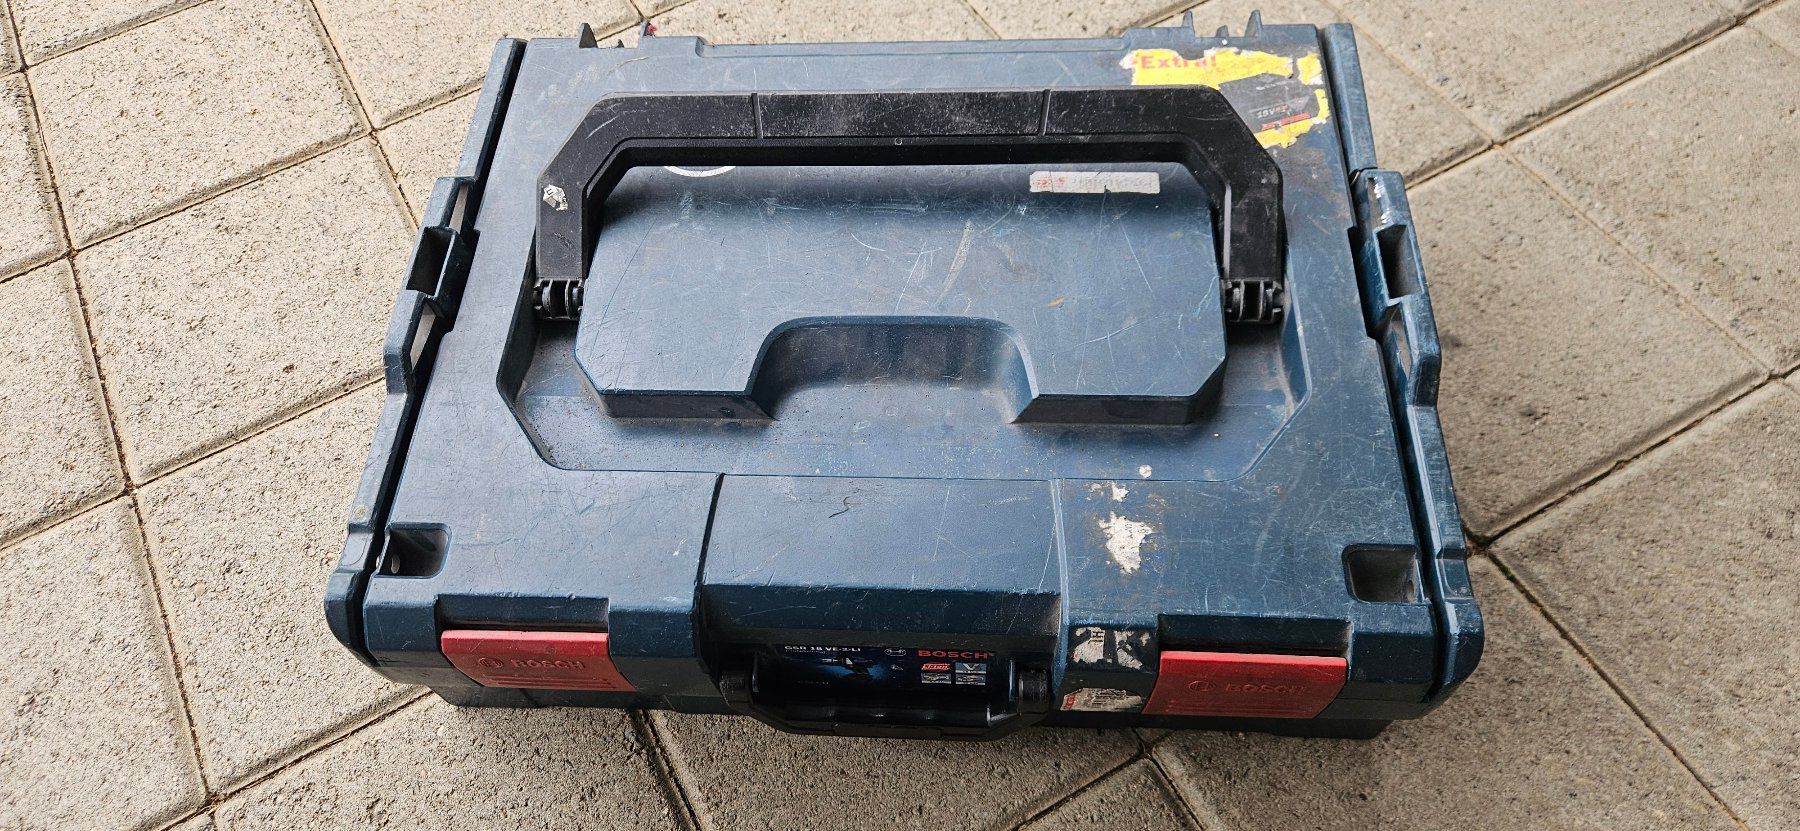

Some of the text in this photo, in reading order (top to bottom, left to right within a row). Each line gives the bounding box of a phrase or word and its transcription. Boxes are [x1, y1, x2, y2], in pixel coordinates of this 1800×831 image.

[917, 649, 989, 659] BOSCH
[510, 658, 587, 670] BOSCH
[1224, 682, 1307, 696] BOSCH
